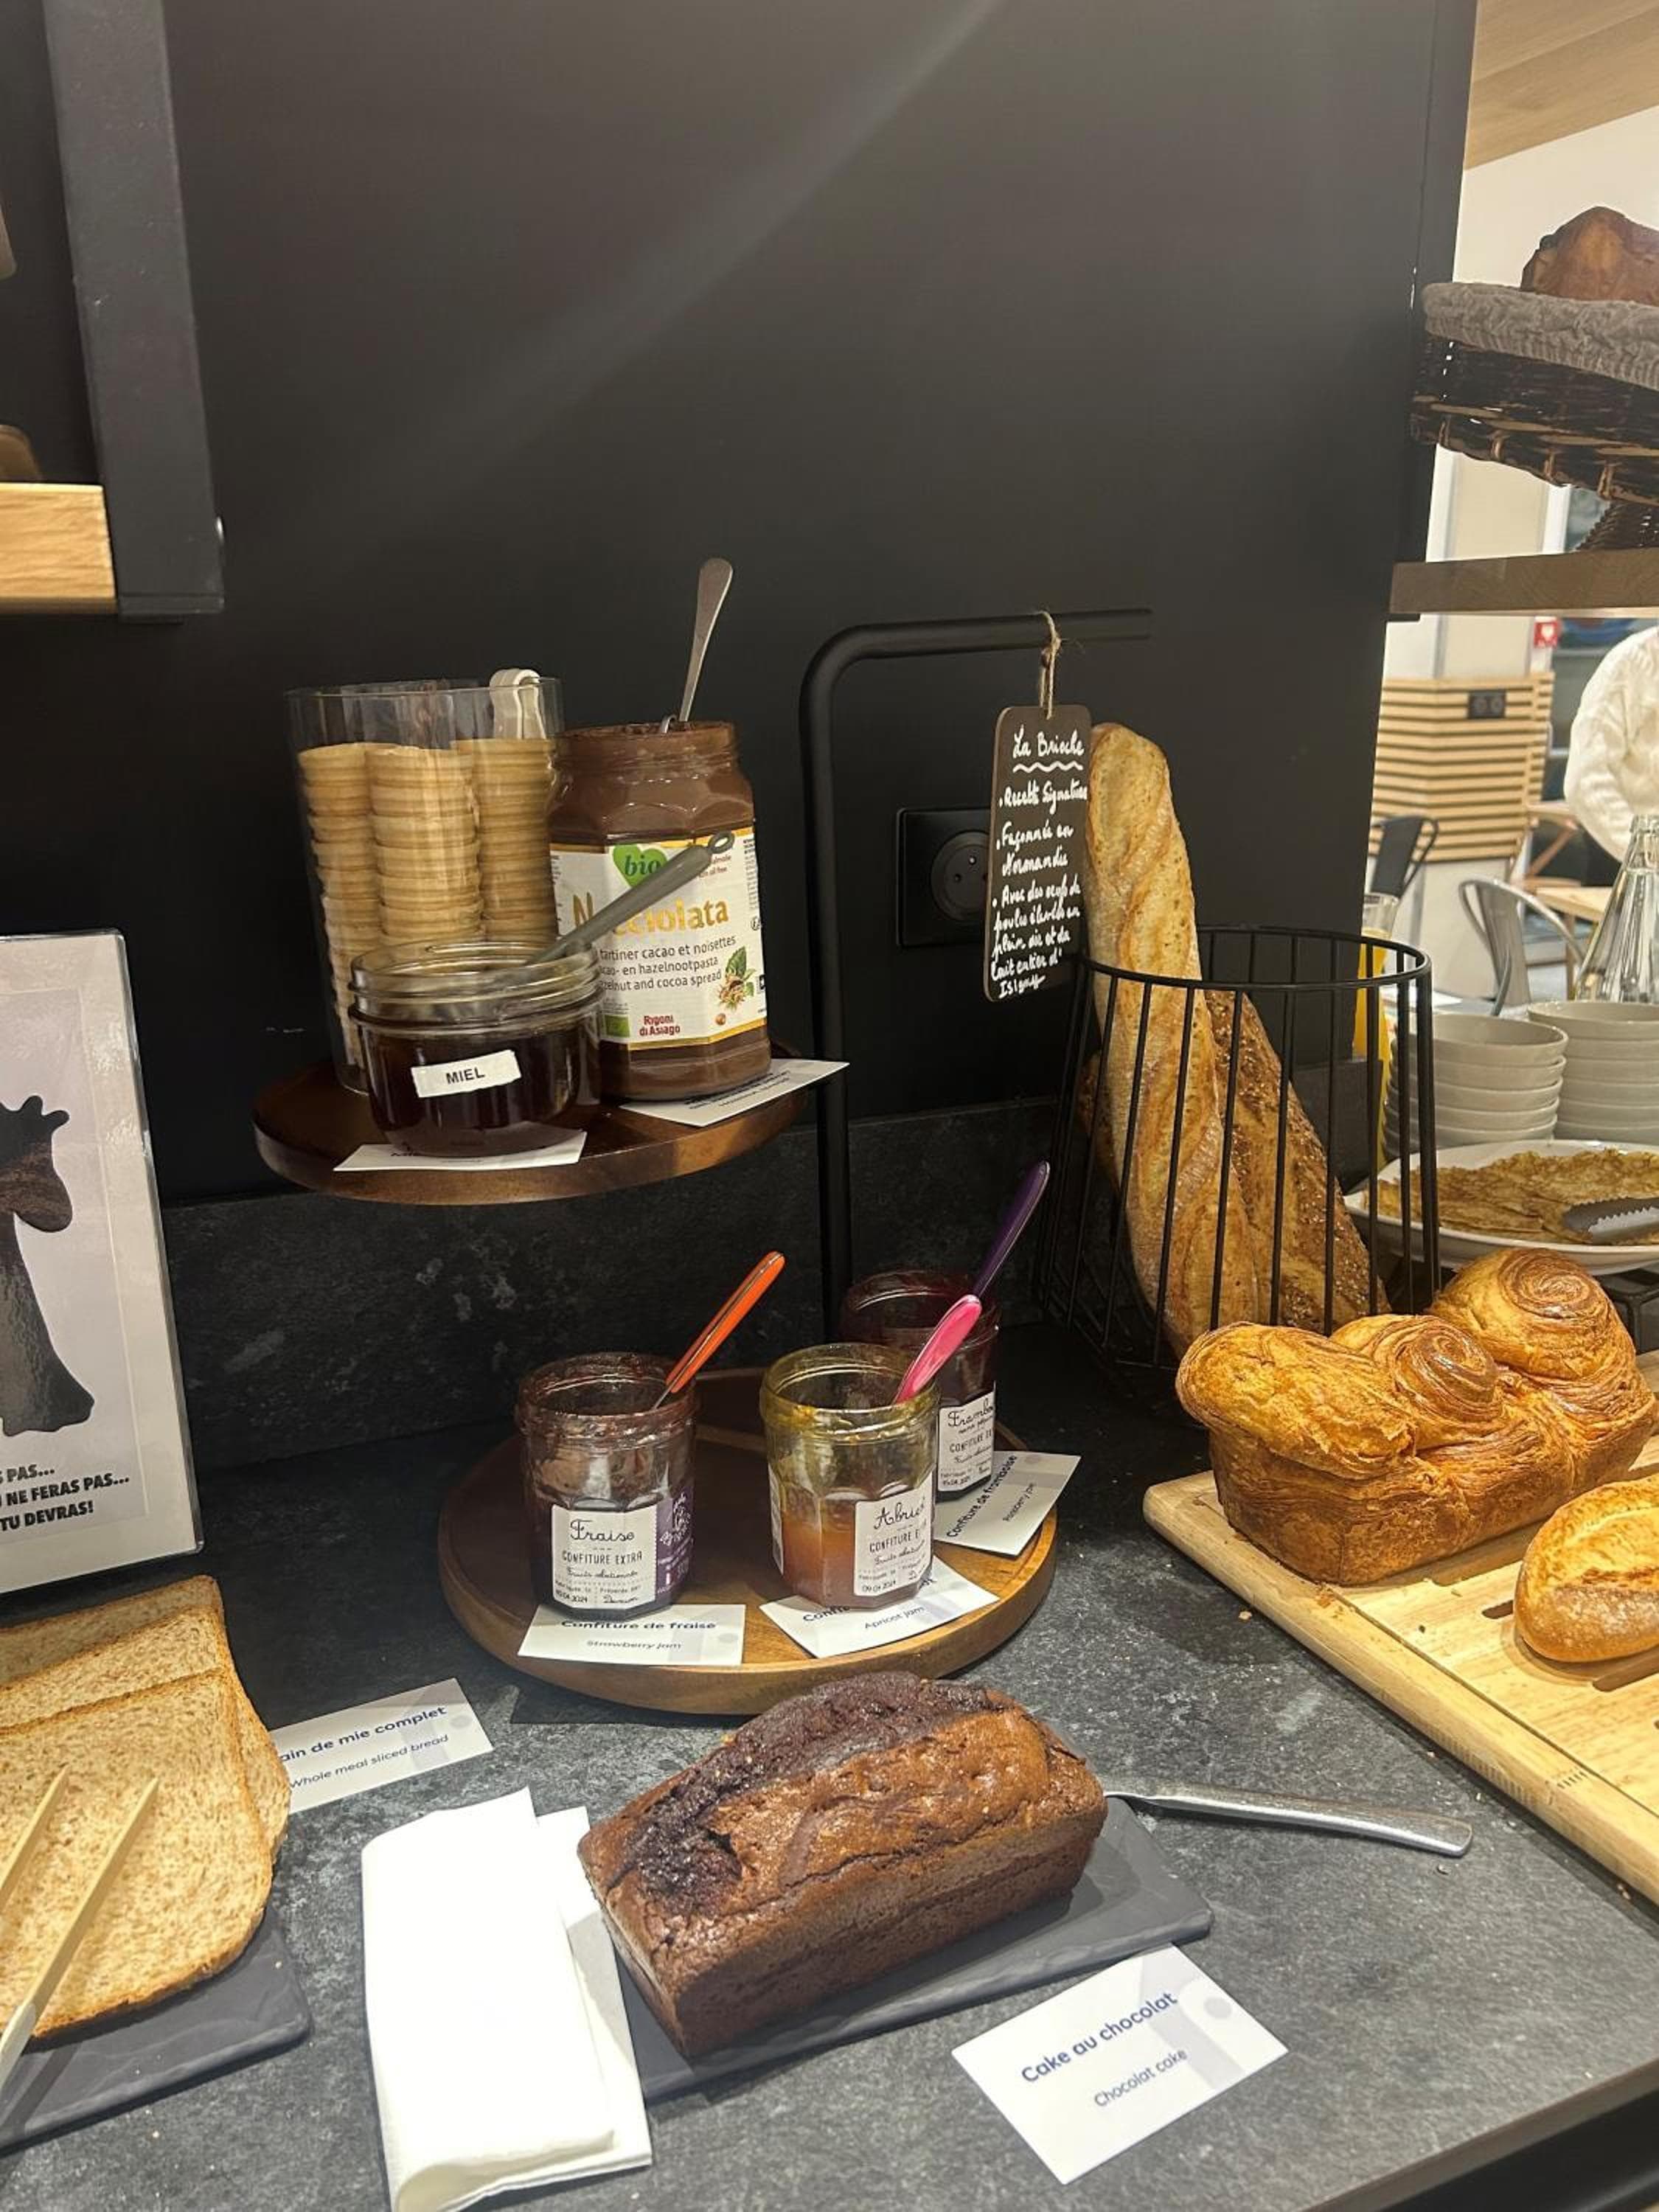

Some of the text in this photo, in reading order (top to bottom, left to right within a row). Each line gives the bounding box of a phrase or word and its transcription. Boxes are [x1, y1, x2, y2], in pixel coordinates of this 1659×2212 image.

[1012, 724, 1085, 759] La Brioche
[625, 854, 661, 877] bio
[572, 891, 729, 937] Nciolata
[641, 946, 675, 959] cacao
[678, 945, 691, 956] et
[694, 935, 737, 955] noisettes
[622, 965, 637, 975] en
[639, 956, 719, 975] hazelnootpasta
[634, 978, 654, 990] and
[657, 977, 688, 989] cocoa
[690, 970, 722, 987] spread
[650, 1025, 681, 1037] Asiago
[445, 1067, 486, 1085] MIEL
[7, 1473, 130, 1507] NE FERAS PAS...
[0, 1500, 94, 1531] TU DEVRAS!
[569, 1518, 636, 1542] Fraise
[869, 1531, 911, 1554] CONFITURE
[562, 1549, 643, 1565] CONFITURE EXTRA
[644, 1621, 665, 1630] de
[669, 1621, 717, 1630] fraise
[279, 1705, 448, 1762] ain de mie complet
[290, 1733, 449, 1789] Whole meal sliced bread
[1021, 1990, 1180, 2083] Cake au chocolat
[1093, 2048, 1188, 2107] Chocolat cake
